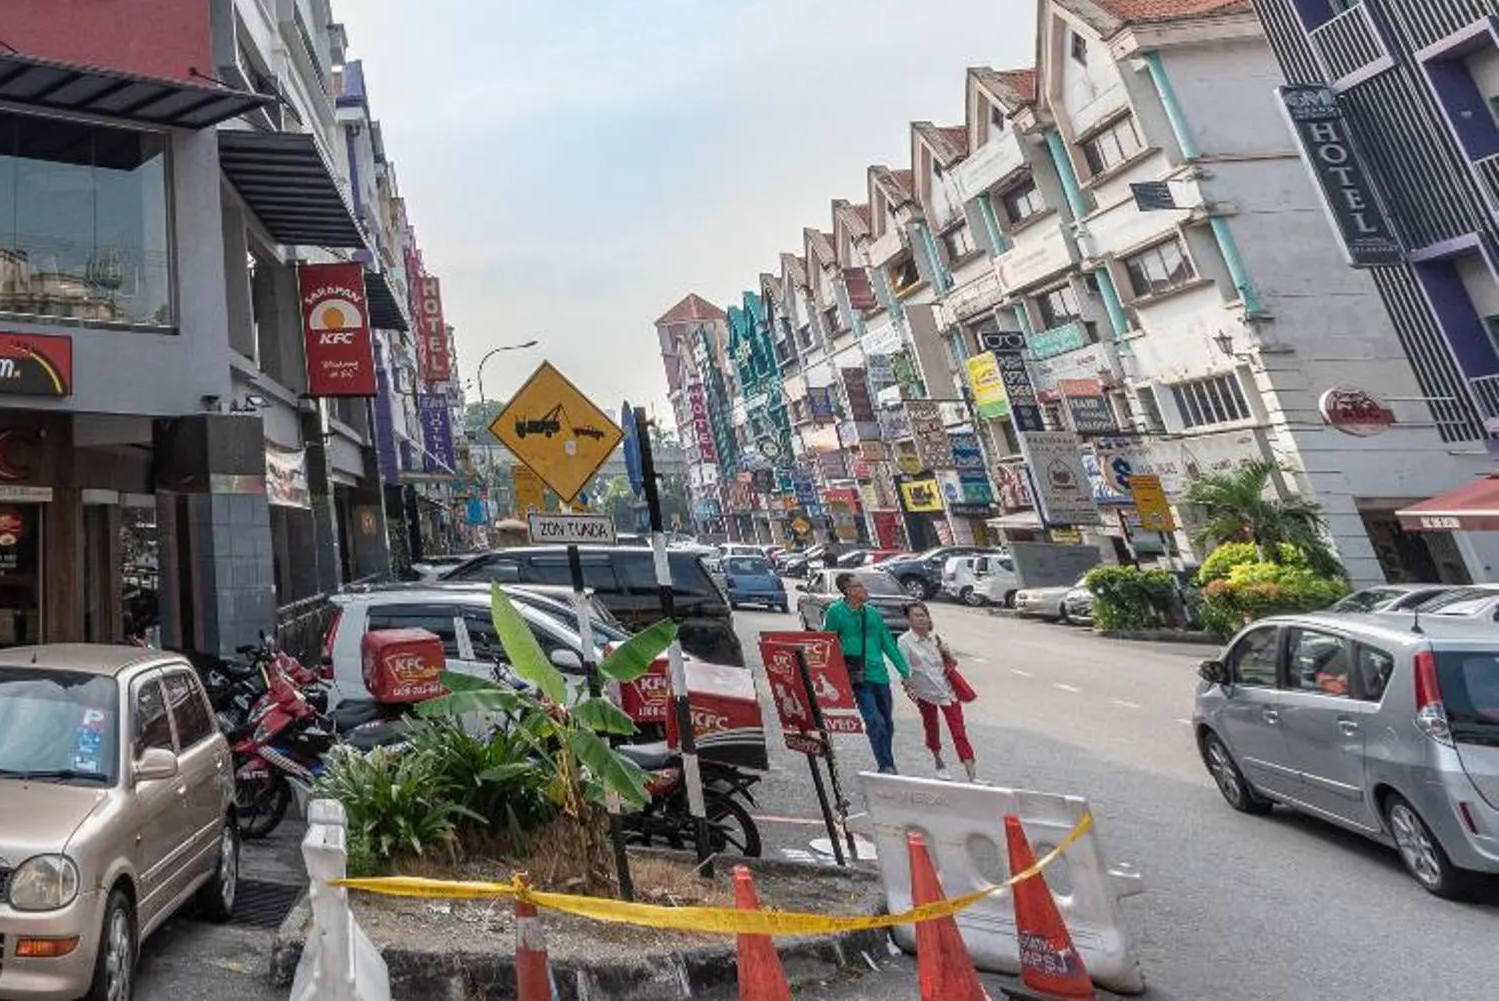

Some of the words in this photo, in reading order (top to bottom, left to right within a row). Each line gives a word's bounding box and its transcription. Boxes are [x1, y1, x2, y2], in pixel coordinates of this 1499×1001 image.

[1309, 122, 1377, 233] HOTEL
[304, 285, 363, 305] SARAPAN
[422, 281, 443, 373] HOTEL
[318, 332, 355, 345] KFC
[689, 389, 713, 459] HOTEL
[540, 521, 565, 536] ZON
[567, 521, 609, 538] TUNDA
[803, 642, 823, 655] FC
[394, 657, 425, 673] KFC
[641, 678, 667, 691] KF
[691, 712, 729, 731] KFC
